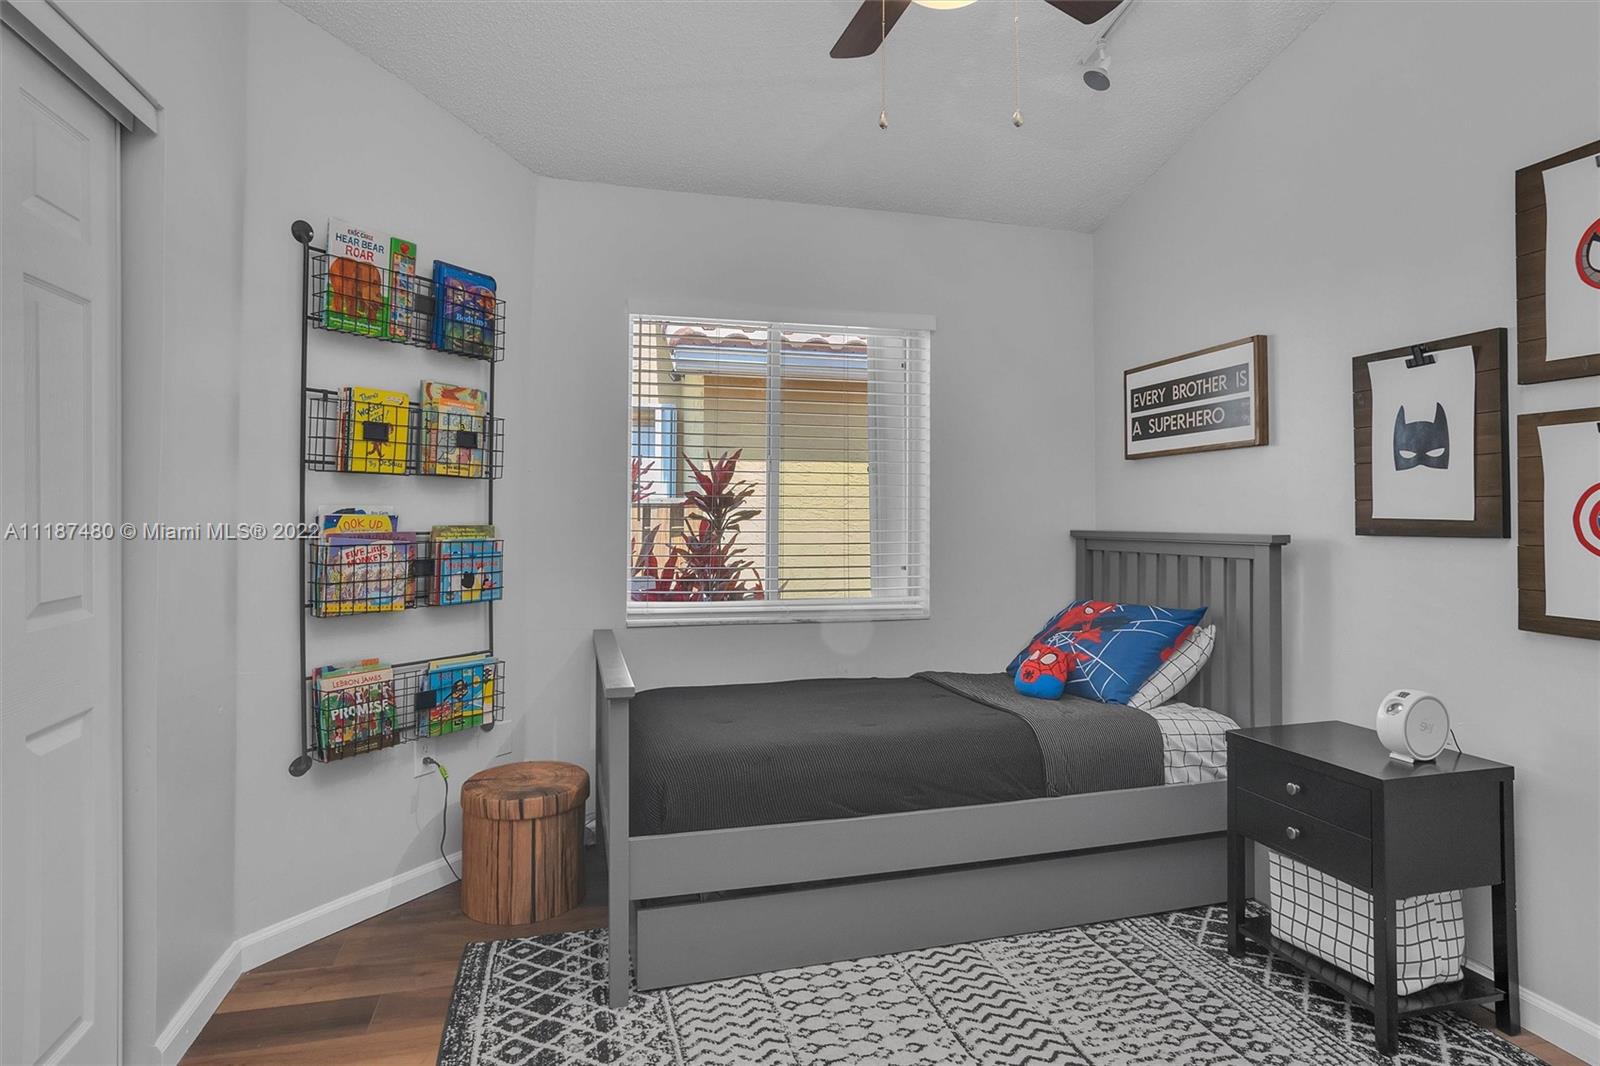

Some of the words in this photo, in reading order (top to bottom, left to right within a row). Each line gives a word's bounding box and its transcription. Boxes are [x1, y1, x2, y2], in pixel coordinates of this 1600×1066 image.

[335, 232, 360, 247] HEAR
[361, 240, 385, 254] BEAR
[345, 244, 374, 262] ROAR
[1133, 388, 1166, 408] EVERY
[1172, 375, 1228, 400] BROTHER
[1236, 370, 1248, 388] IS
[1132, 422, 1142, 436] A
[1148, 407, 1225, 434] SUPERHERO
[345, 548, 365, 560] FIVE
[347, 552, 389, 568] MONKEYS
[332, 679, 360, 689] LEBRON
[361, 674, 383, 684] JAMES
[330, 699, 389, 721] PROMISE
